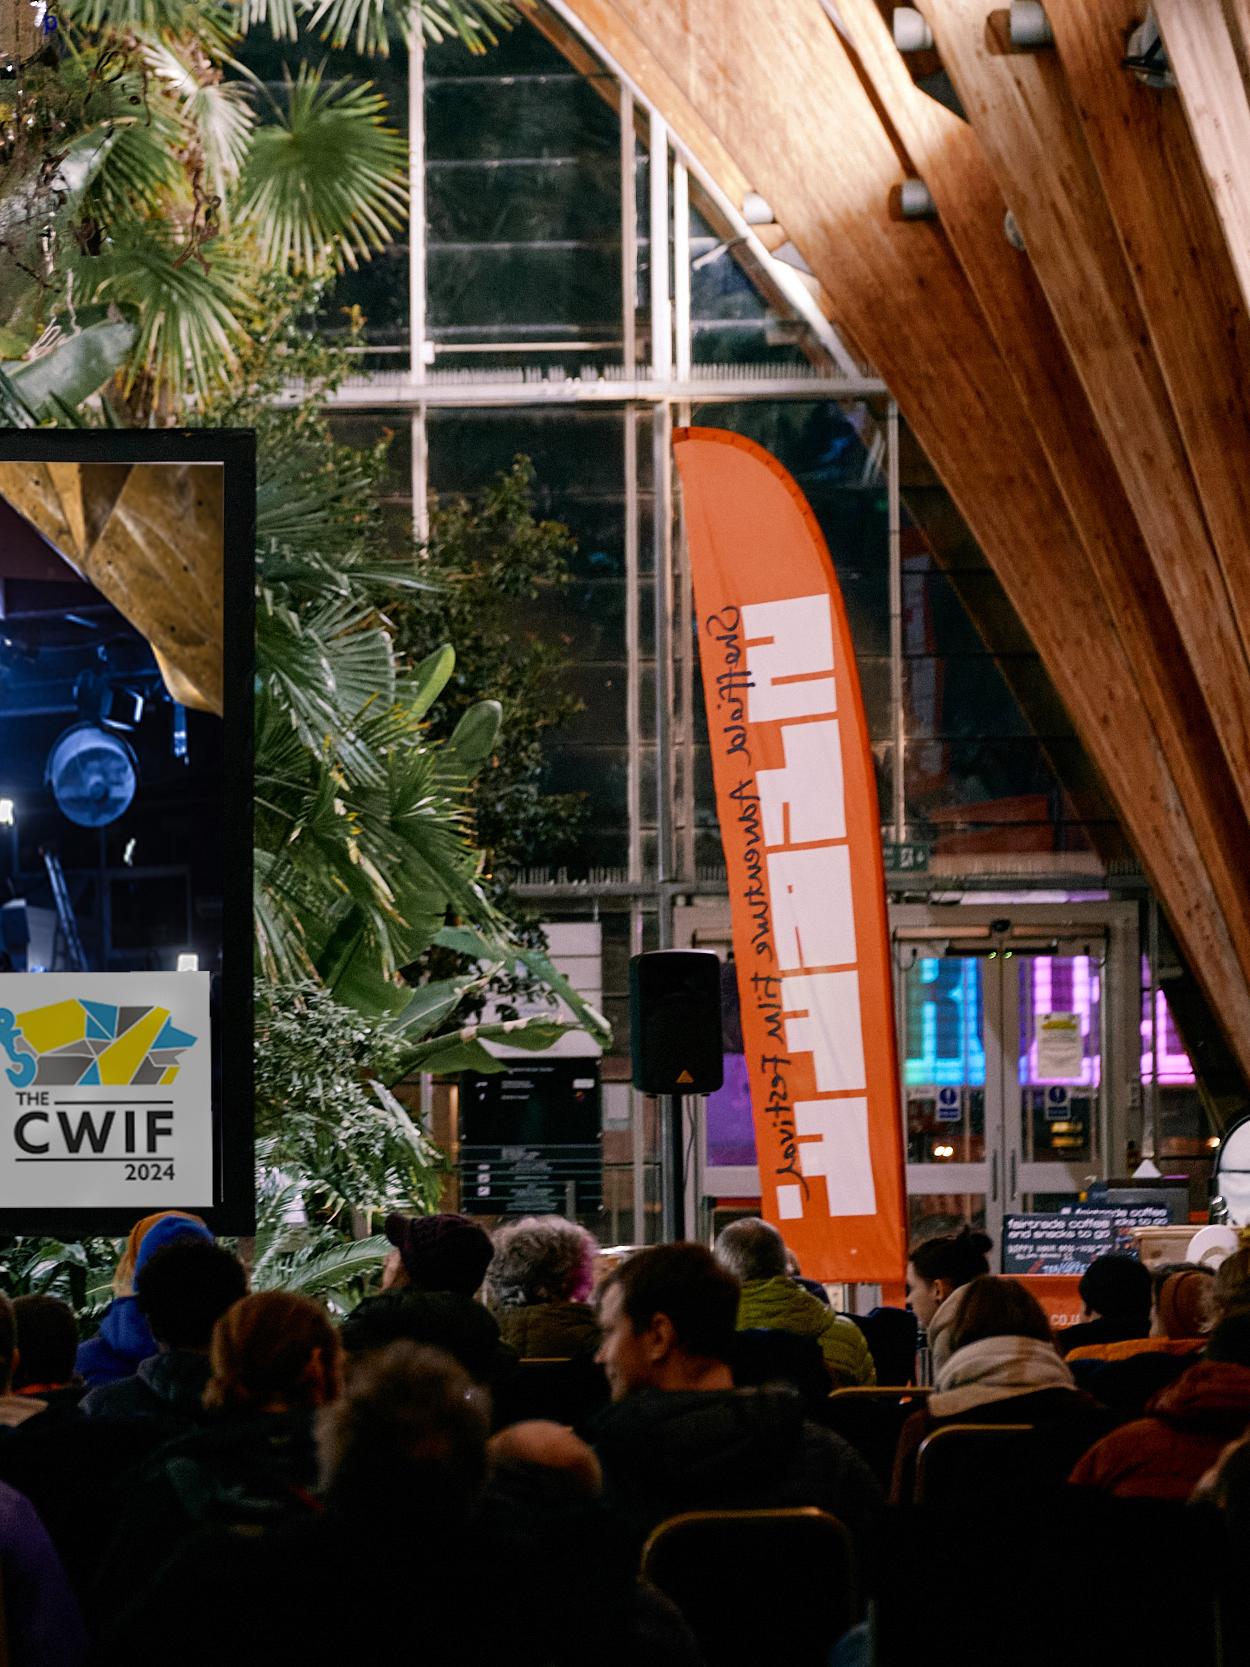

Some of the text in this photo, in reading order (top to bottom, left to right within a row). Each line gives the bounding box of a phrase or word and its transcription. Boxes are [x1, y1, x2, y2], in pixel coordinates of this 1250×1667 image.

[15, 1092, 49, 1106] THE
[14, 1110, 174, 1154] CWIF
[125, 1164, 175, 1181] 2024
[1068, 1218, 1110, 1228] coffee
